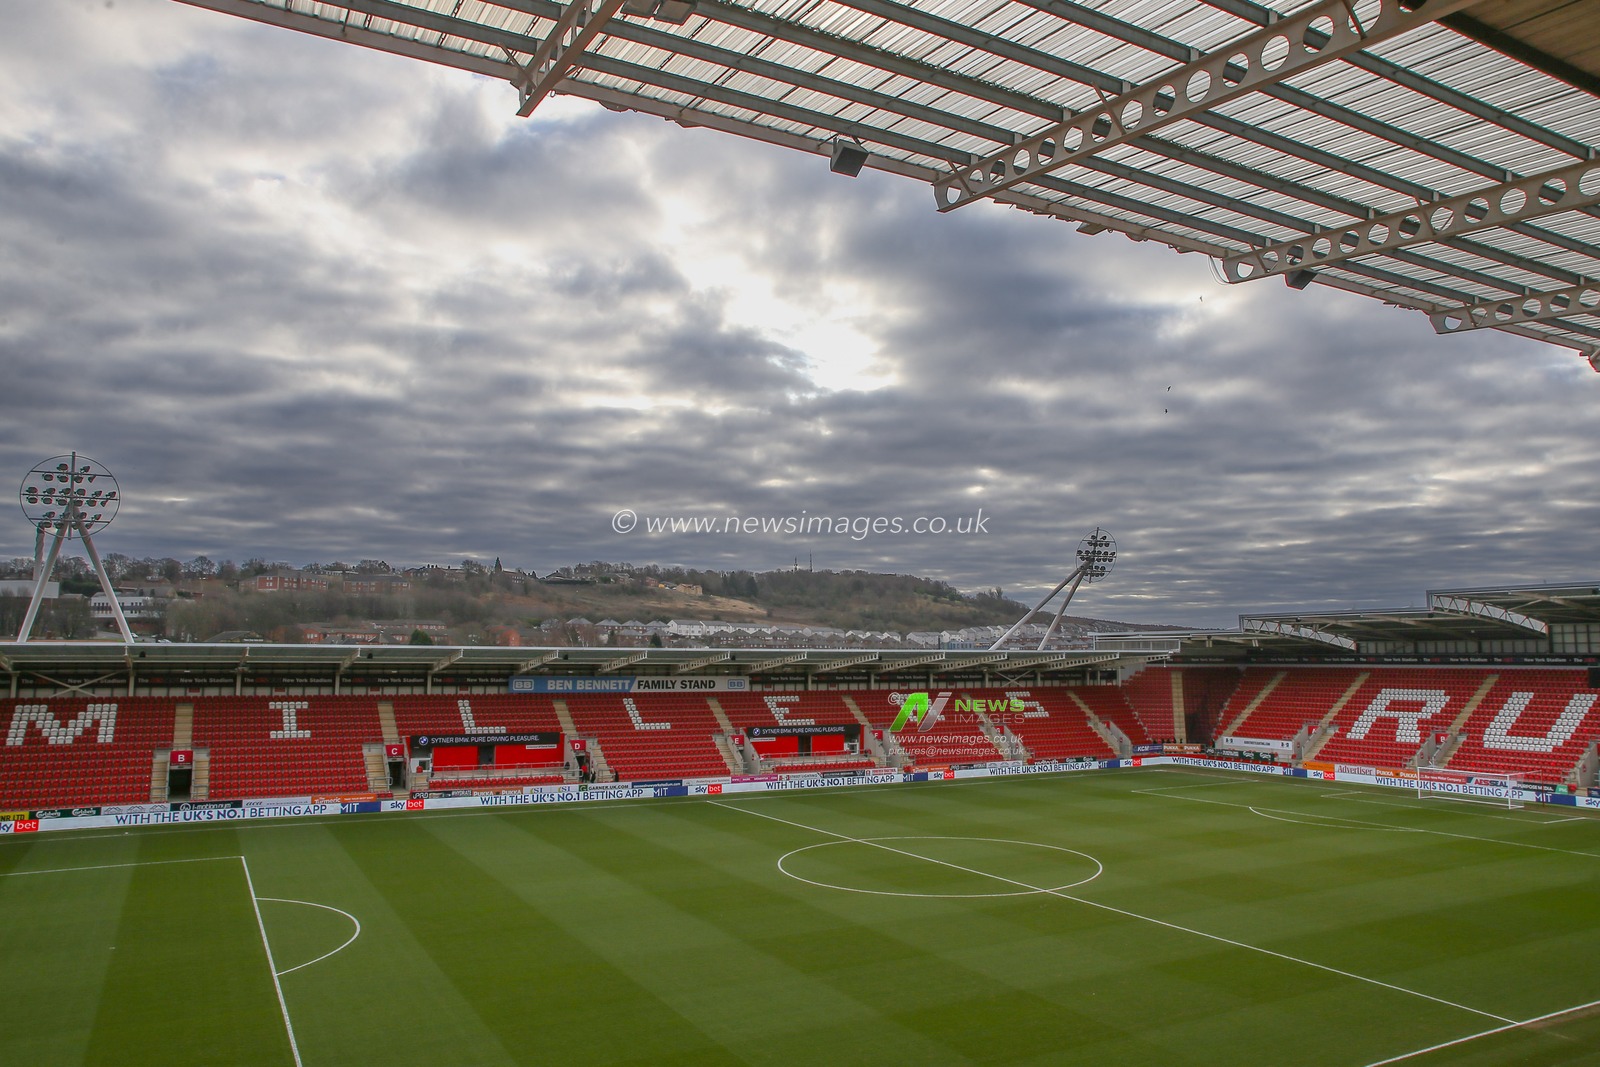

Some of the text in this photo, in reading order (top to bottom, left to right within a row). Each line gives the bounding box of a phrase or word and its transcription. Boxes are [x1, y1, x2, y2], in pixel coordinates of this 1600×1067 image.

[548, 680, 572, 690] BEN
[577, 680, 630, 690] BENNETT
[638, 680, 676, 689] FAMILY
[680, 680, 716, 689] STAND
[1346, 688, 1598, 752] R U
[1054, 763, 1079, 772] BETTING
[1203, 759, 1217, 768] UK'S
[1218, 761, 1233, 769] NO.1
[1234, 762, 1261, 772] BETTING
[1338, 766, 1373, 775] Advertiser
[807, 778, 825, 787] UK'S
[827, 778, 845, 786] NO.1
[847, 776, 879, 785] BETTING
[1475, 779, 1508, 787] AESSEAL
[1376, 777, 1523, 799] WITH THE UKS NO.1 BETTING APP
[480, 789, 643, 805] WITH THE UK'S NO.1 BETTING APP
[391, 800, 405, 809] sky
[1586, 798, 1600, 808] sky
[116, 804, 327, 825] WITH THE UK'S NO.1 BETTING APP
[17, 821, 36, 830] bet
